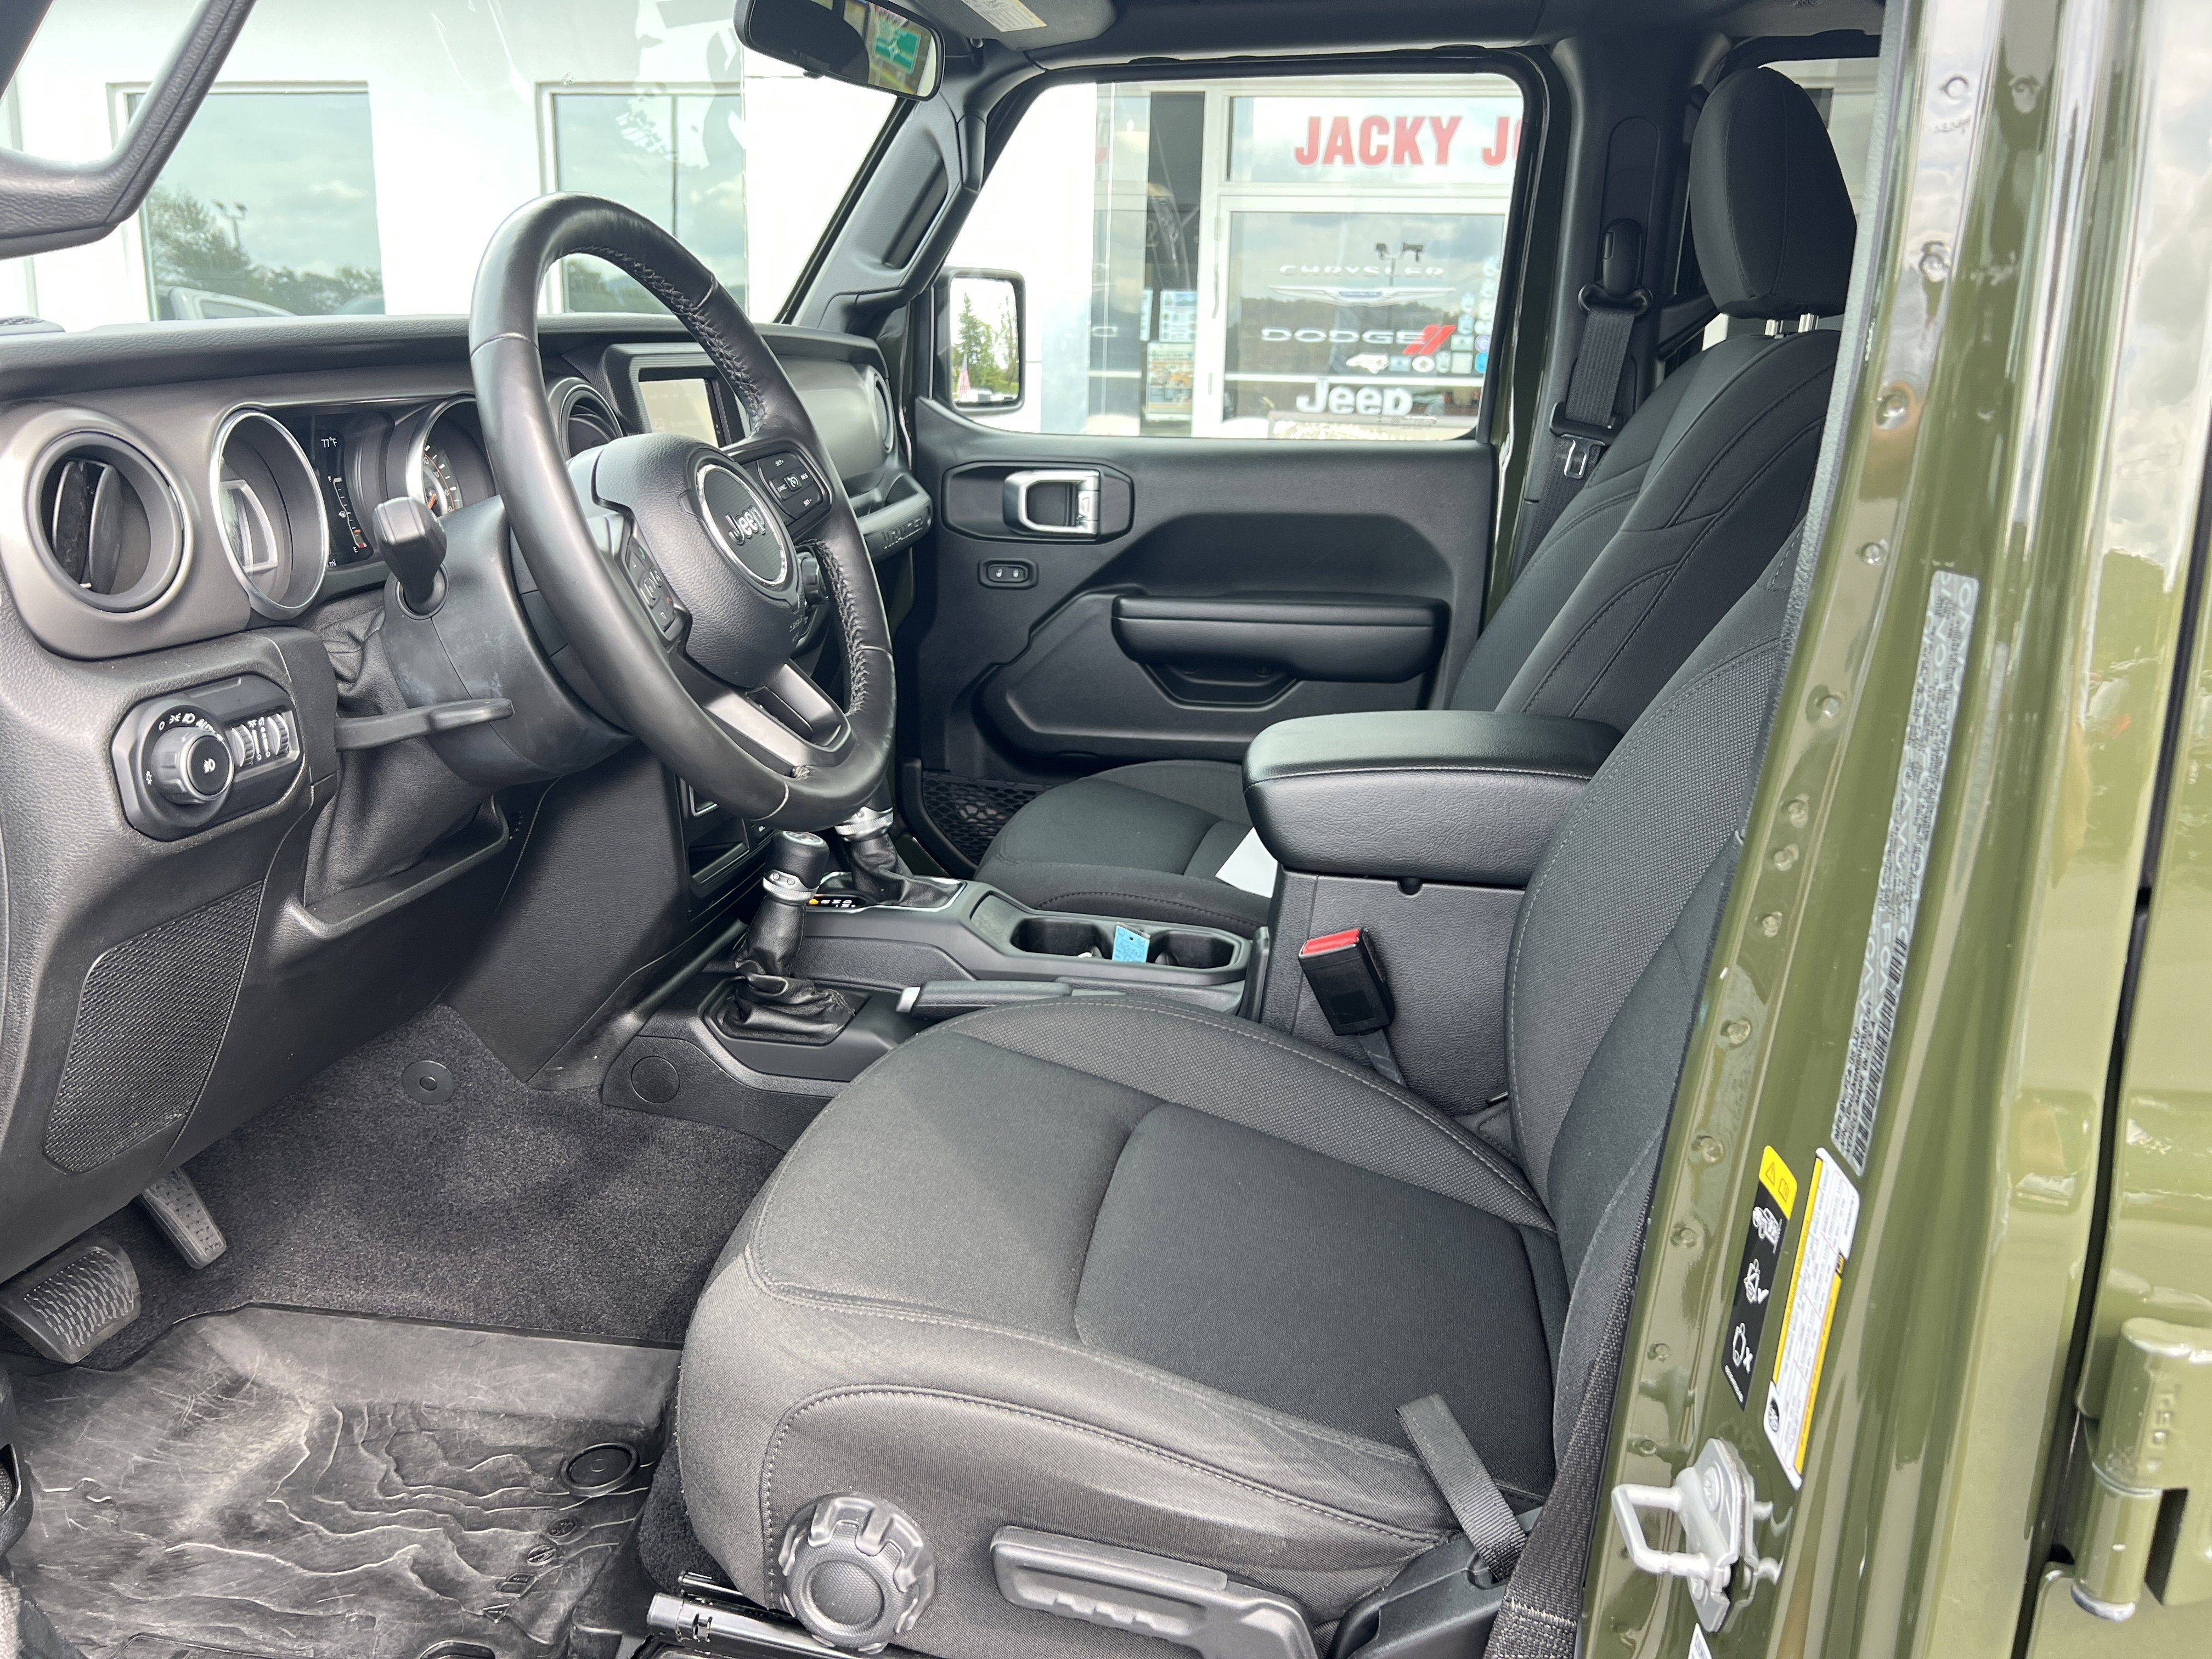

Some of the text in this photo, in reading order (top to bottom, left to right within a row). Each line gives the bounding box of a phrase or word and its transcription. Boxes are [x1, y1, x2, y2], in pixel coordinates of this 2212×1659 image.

[1294, 115, 1523, 168] JACKY J
[1261, 329, 1426, 345] DODGE
[321, 437, 337, 448] 77°F
[725, 506, 766, 545] Jeep
